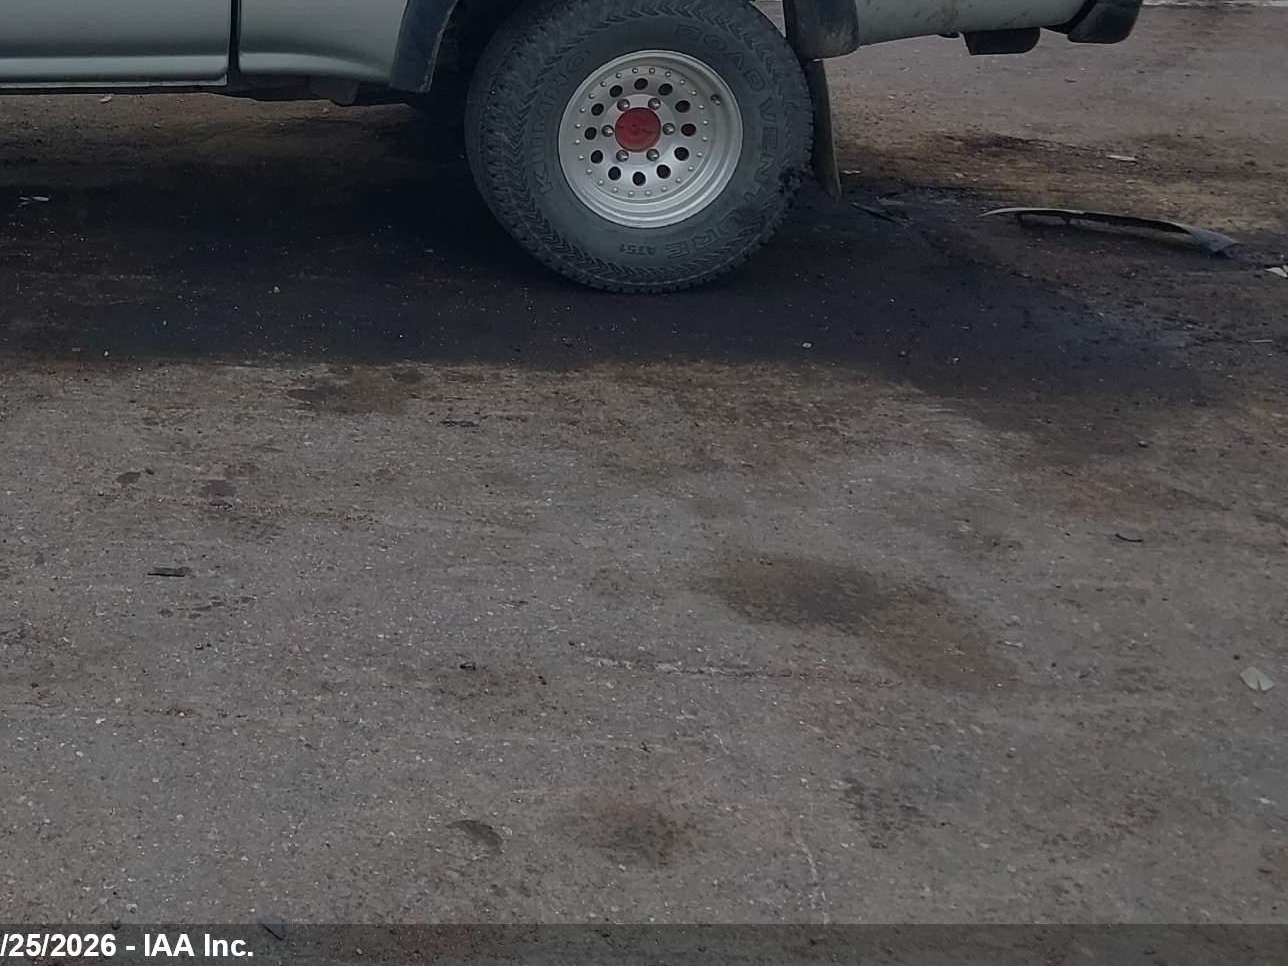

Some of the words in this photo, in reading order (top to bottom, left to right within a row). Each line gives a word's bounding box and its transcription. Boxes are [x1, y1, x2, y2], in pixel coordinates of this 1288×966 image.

[530, 49, 594, 196] KUMHO
[674, 22, 765, 92] ROAD
[664, 97, 780, 259] VENTURE
